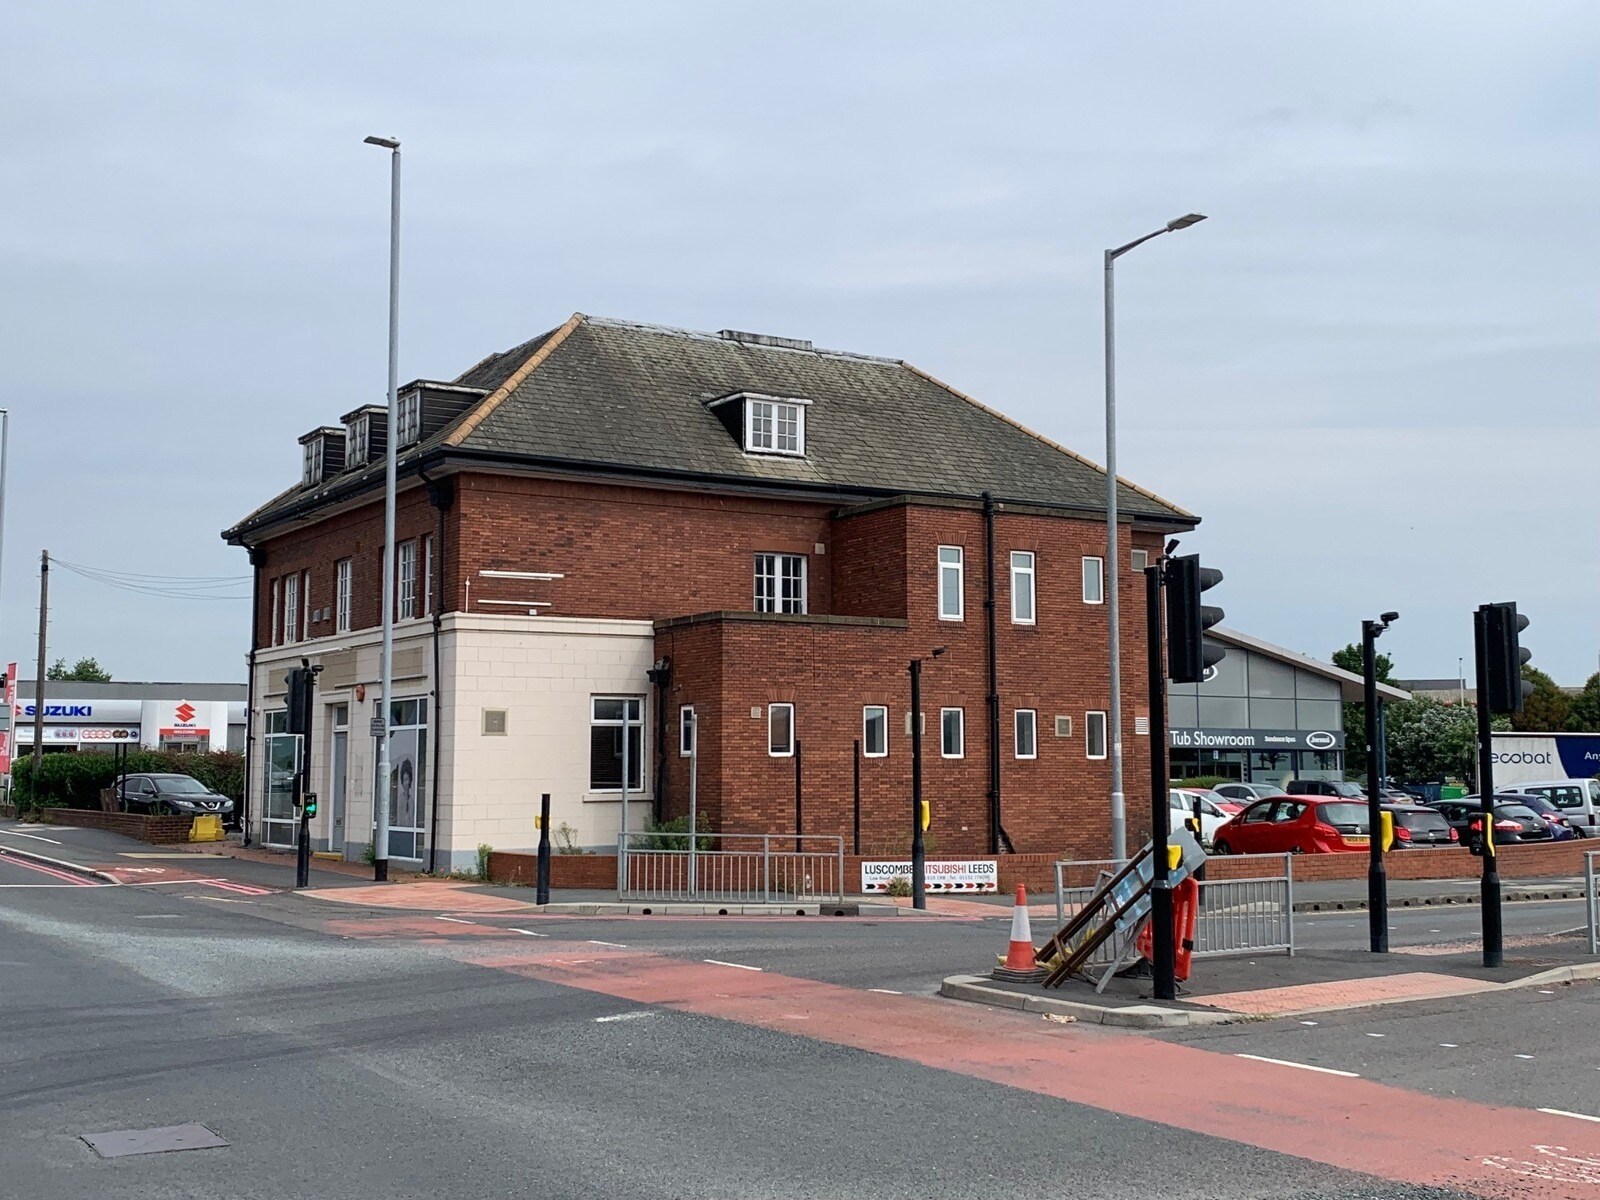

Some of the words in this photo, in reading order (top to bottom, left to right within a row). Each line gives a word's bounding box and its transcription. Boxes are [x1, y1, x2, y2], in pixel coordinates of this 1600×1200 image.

[25, 706, 92, 717] SUZUKI
[1169, 730, 1191, 745] Tub
[1194, 731, 1255, 747] Showroom
[1491, 751, 1552, 765] ecobat
[1584, 751, 1600, 761] An
[925, 864, 967, 874] ITSUBISHI
[968, 863, 995, 874] LEEDS
